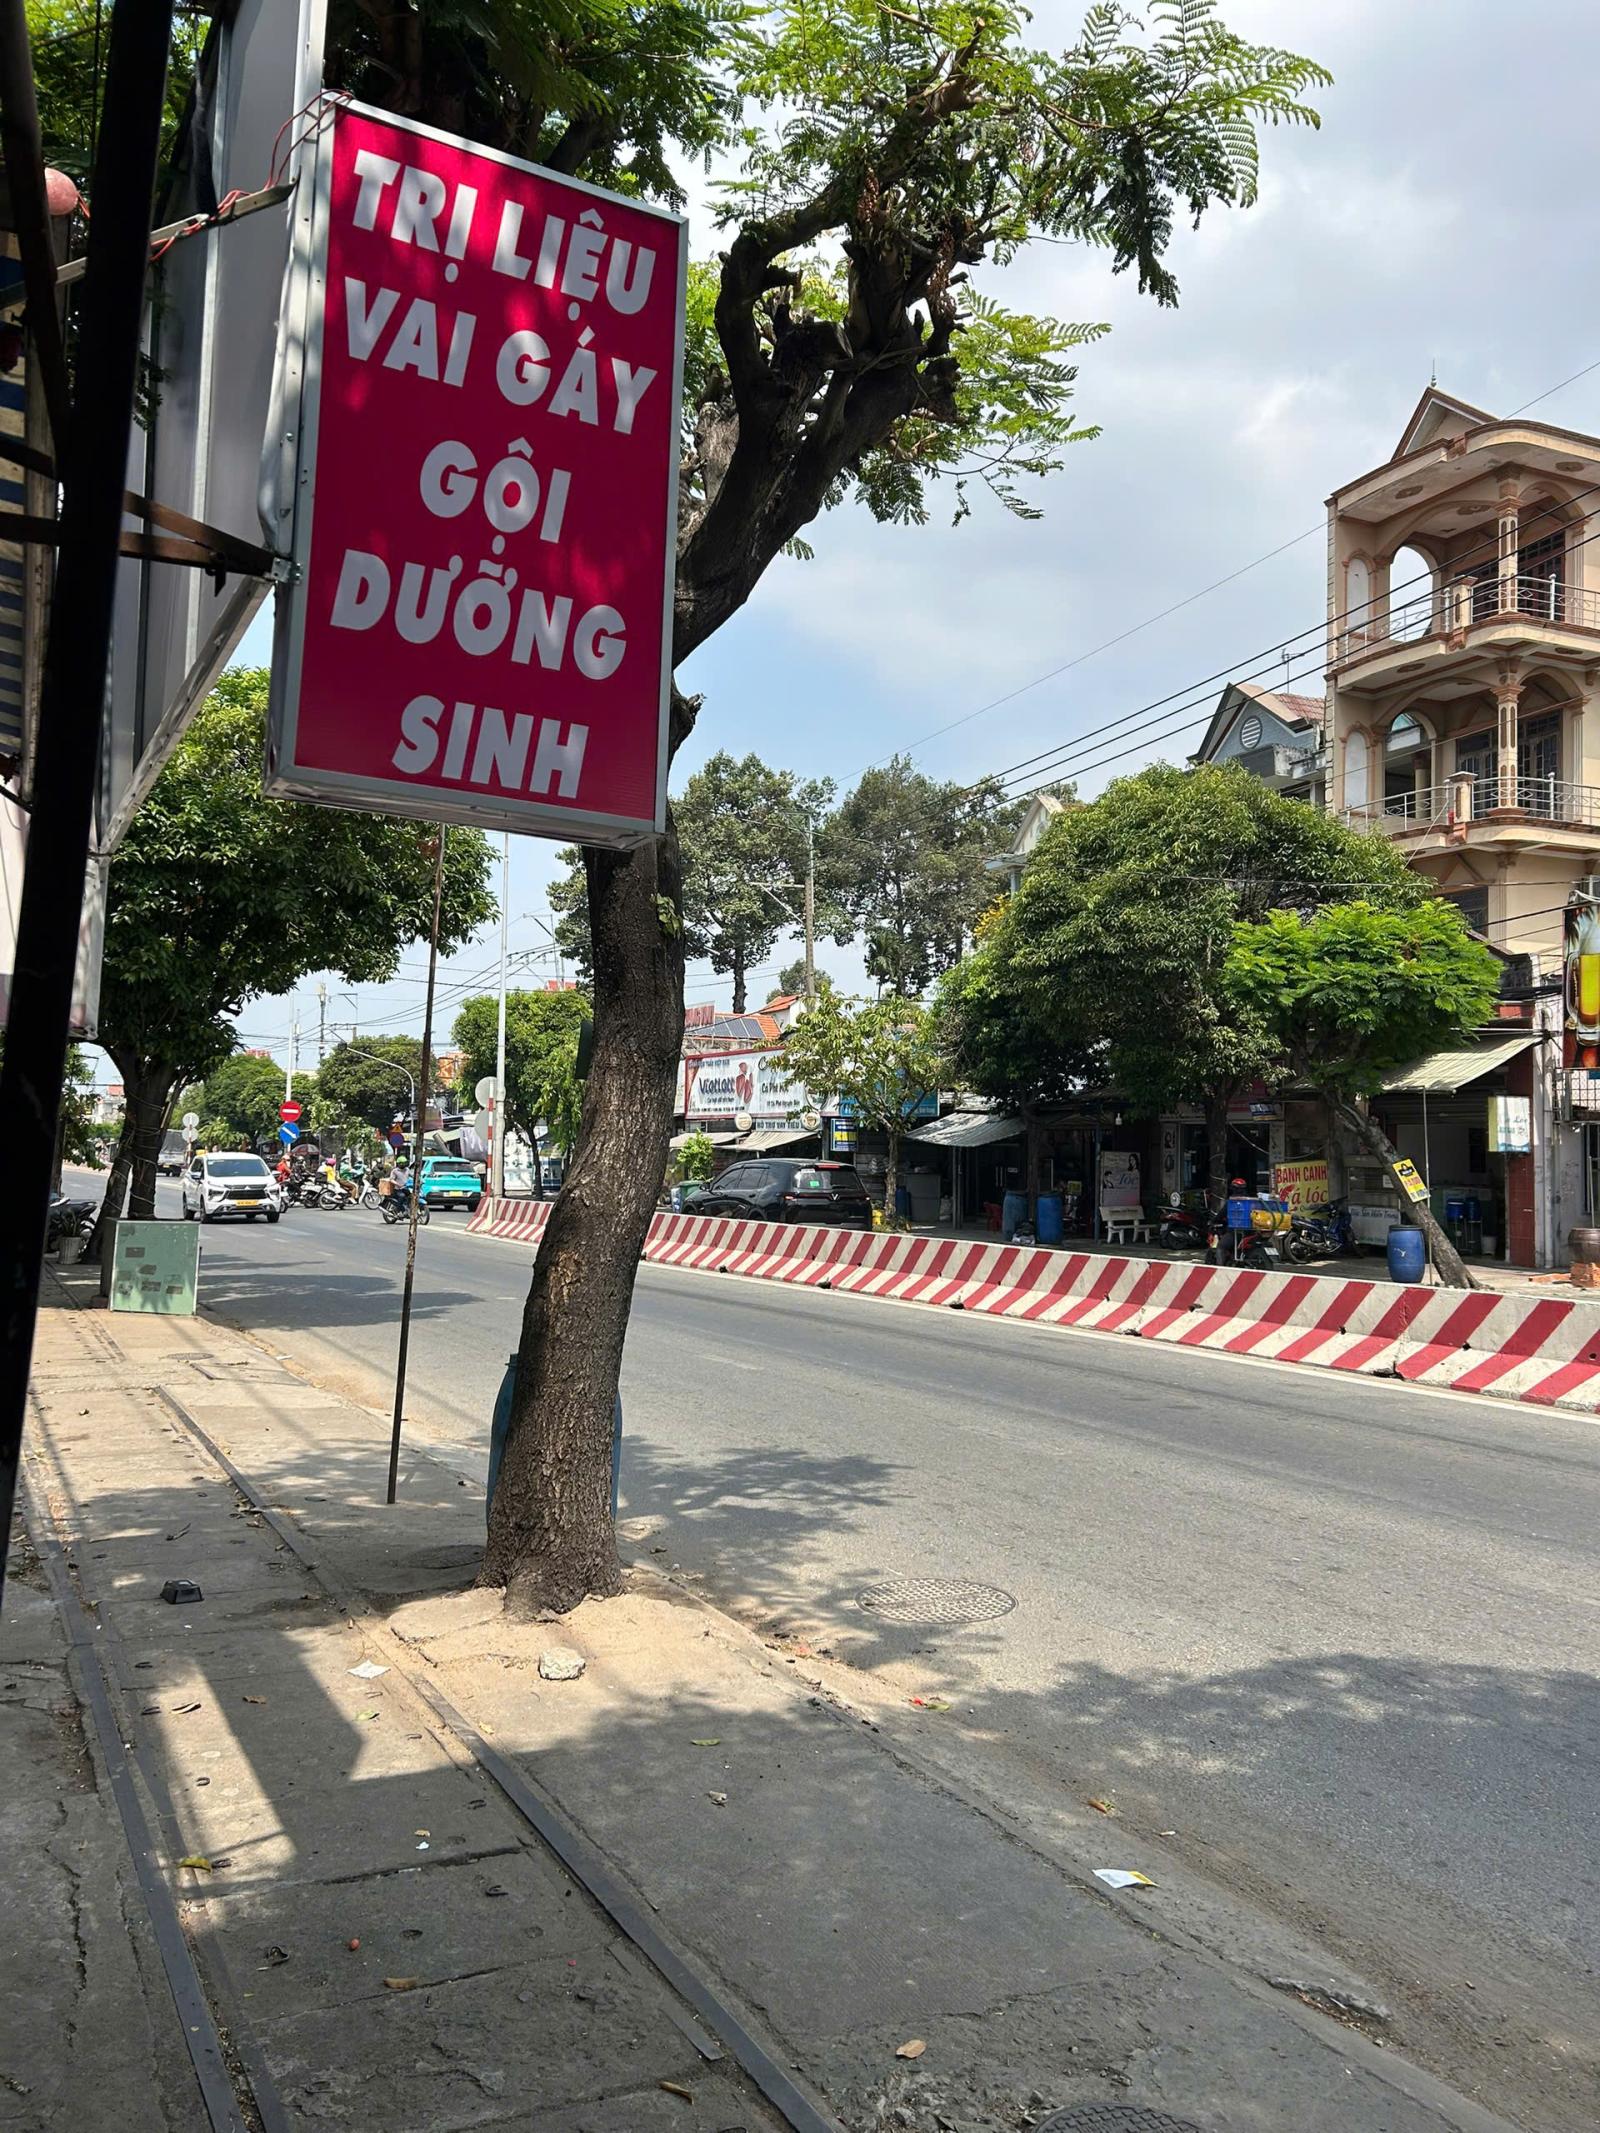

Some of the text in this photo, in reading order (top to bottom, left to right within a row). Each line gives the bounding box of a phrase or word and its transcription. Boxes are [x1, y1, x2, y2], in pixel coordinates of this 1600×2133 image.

[352, 149, 656, 322] TRỊ LIỆU
[343, 276, 658, 435] VAI GÁY
[419, 437, 571, 555] GỘI
[331, 548, 627, 681] DƯỠNG
[392, 694, 589, 799] SINH
[1303, 1165, 1327, 1181] CANH
